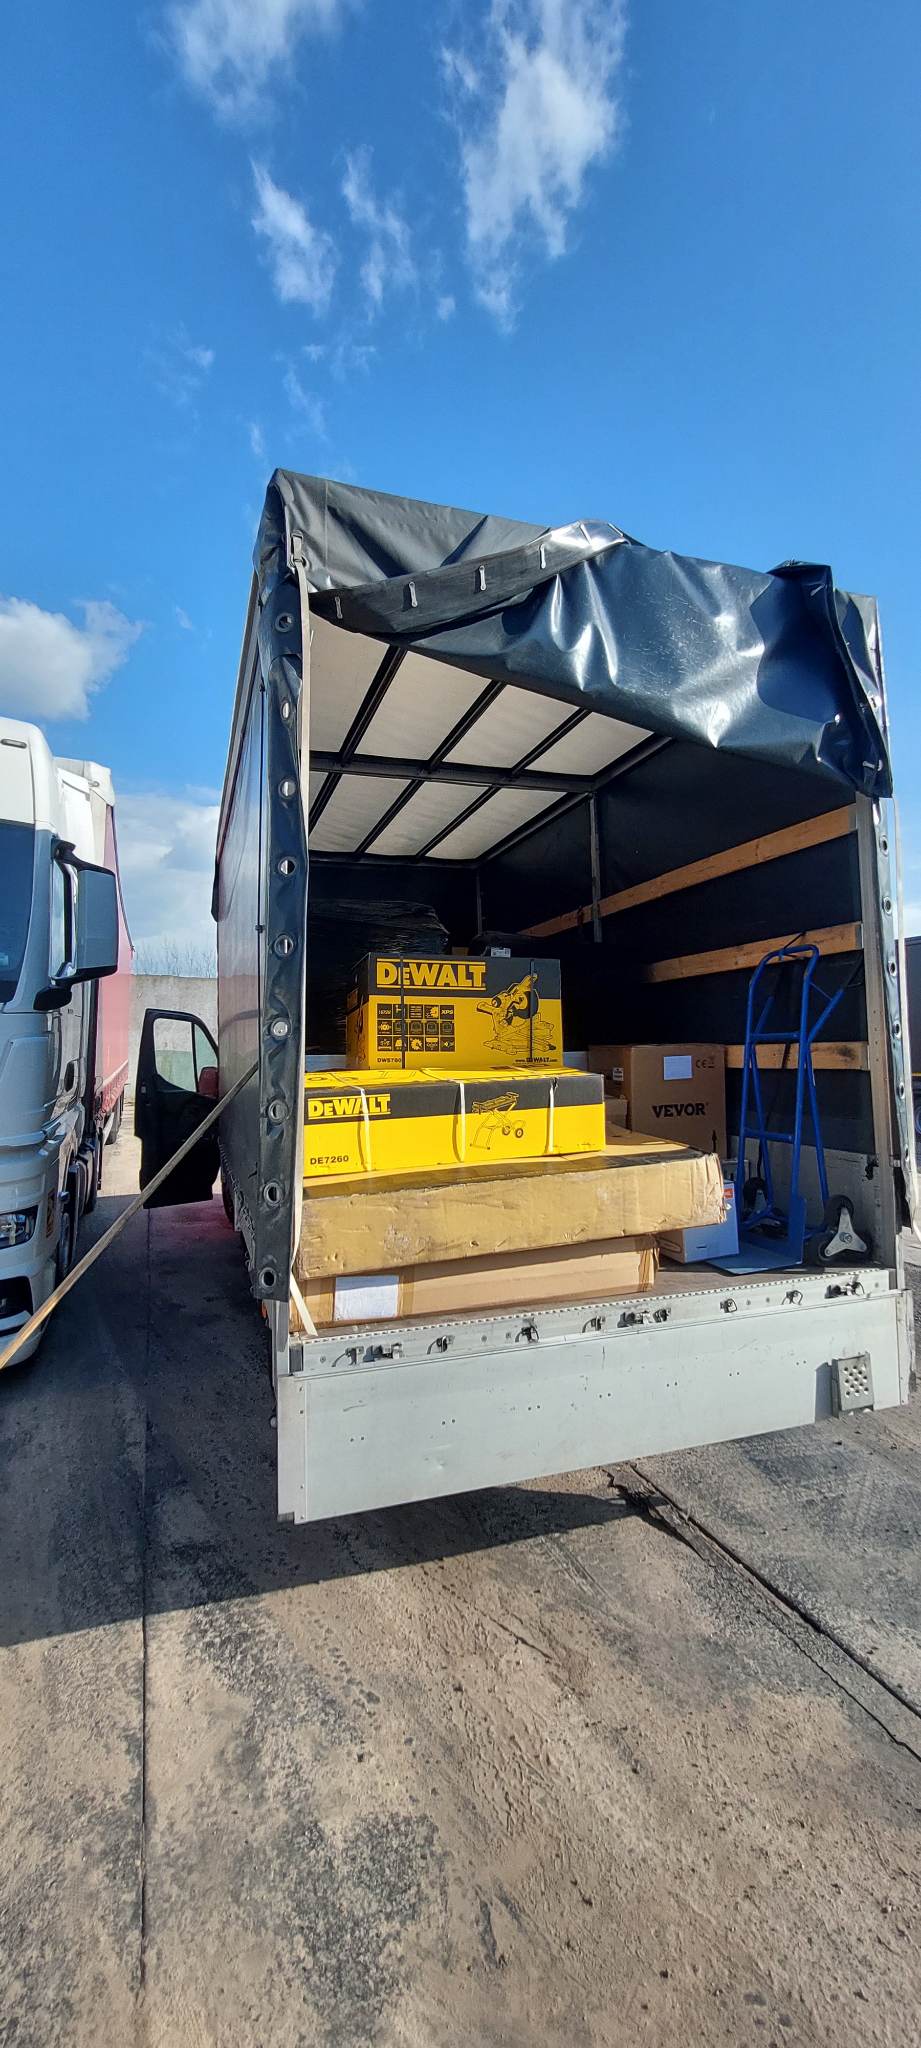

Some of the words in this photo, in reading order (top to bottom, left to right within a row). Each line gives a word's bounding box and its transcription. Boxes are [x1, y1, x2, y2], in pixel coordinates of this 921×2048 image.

[377, 962, 486, 987] DEWALT
[652, 1103, 705, 1118] VEVOR
[310, 1155, 349, 1165] DE7260
